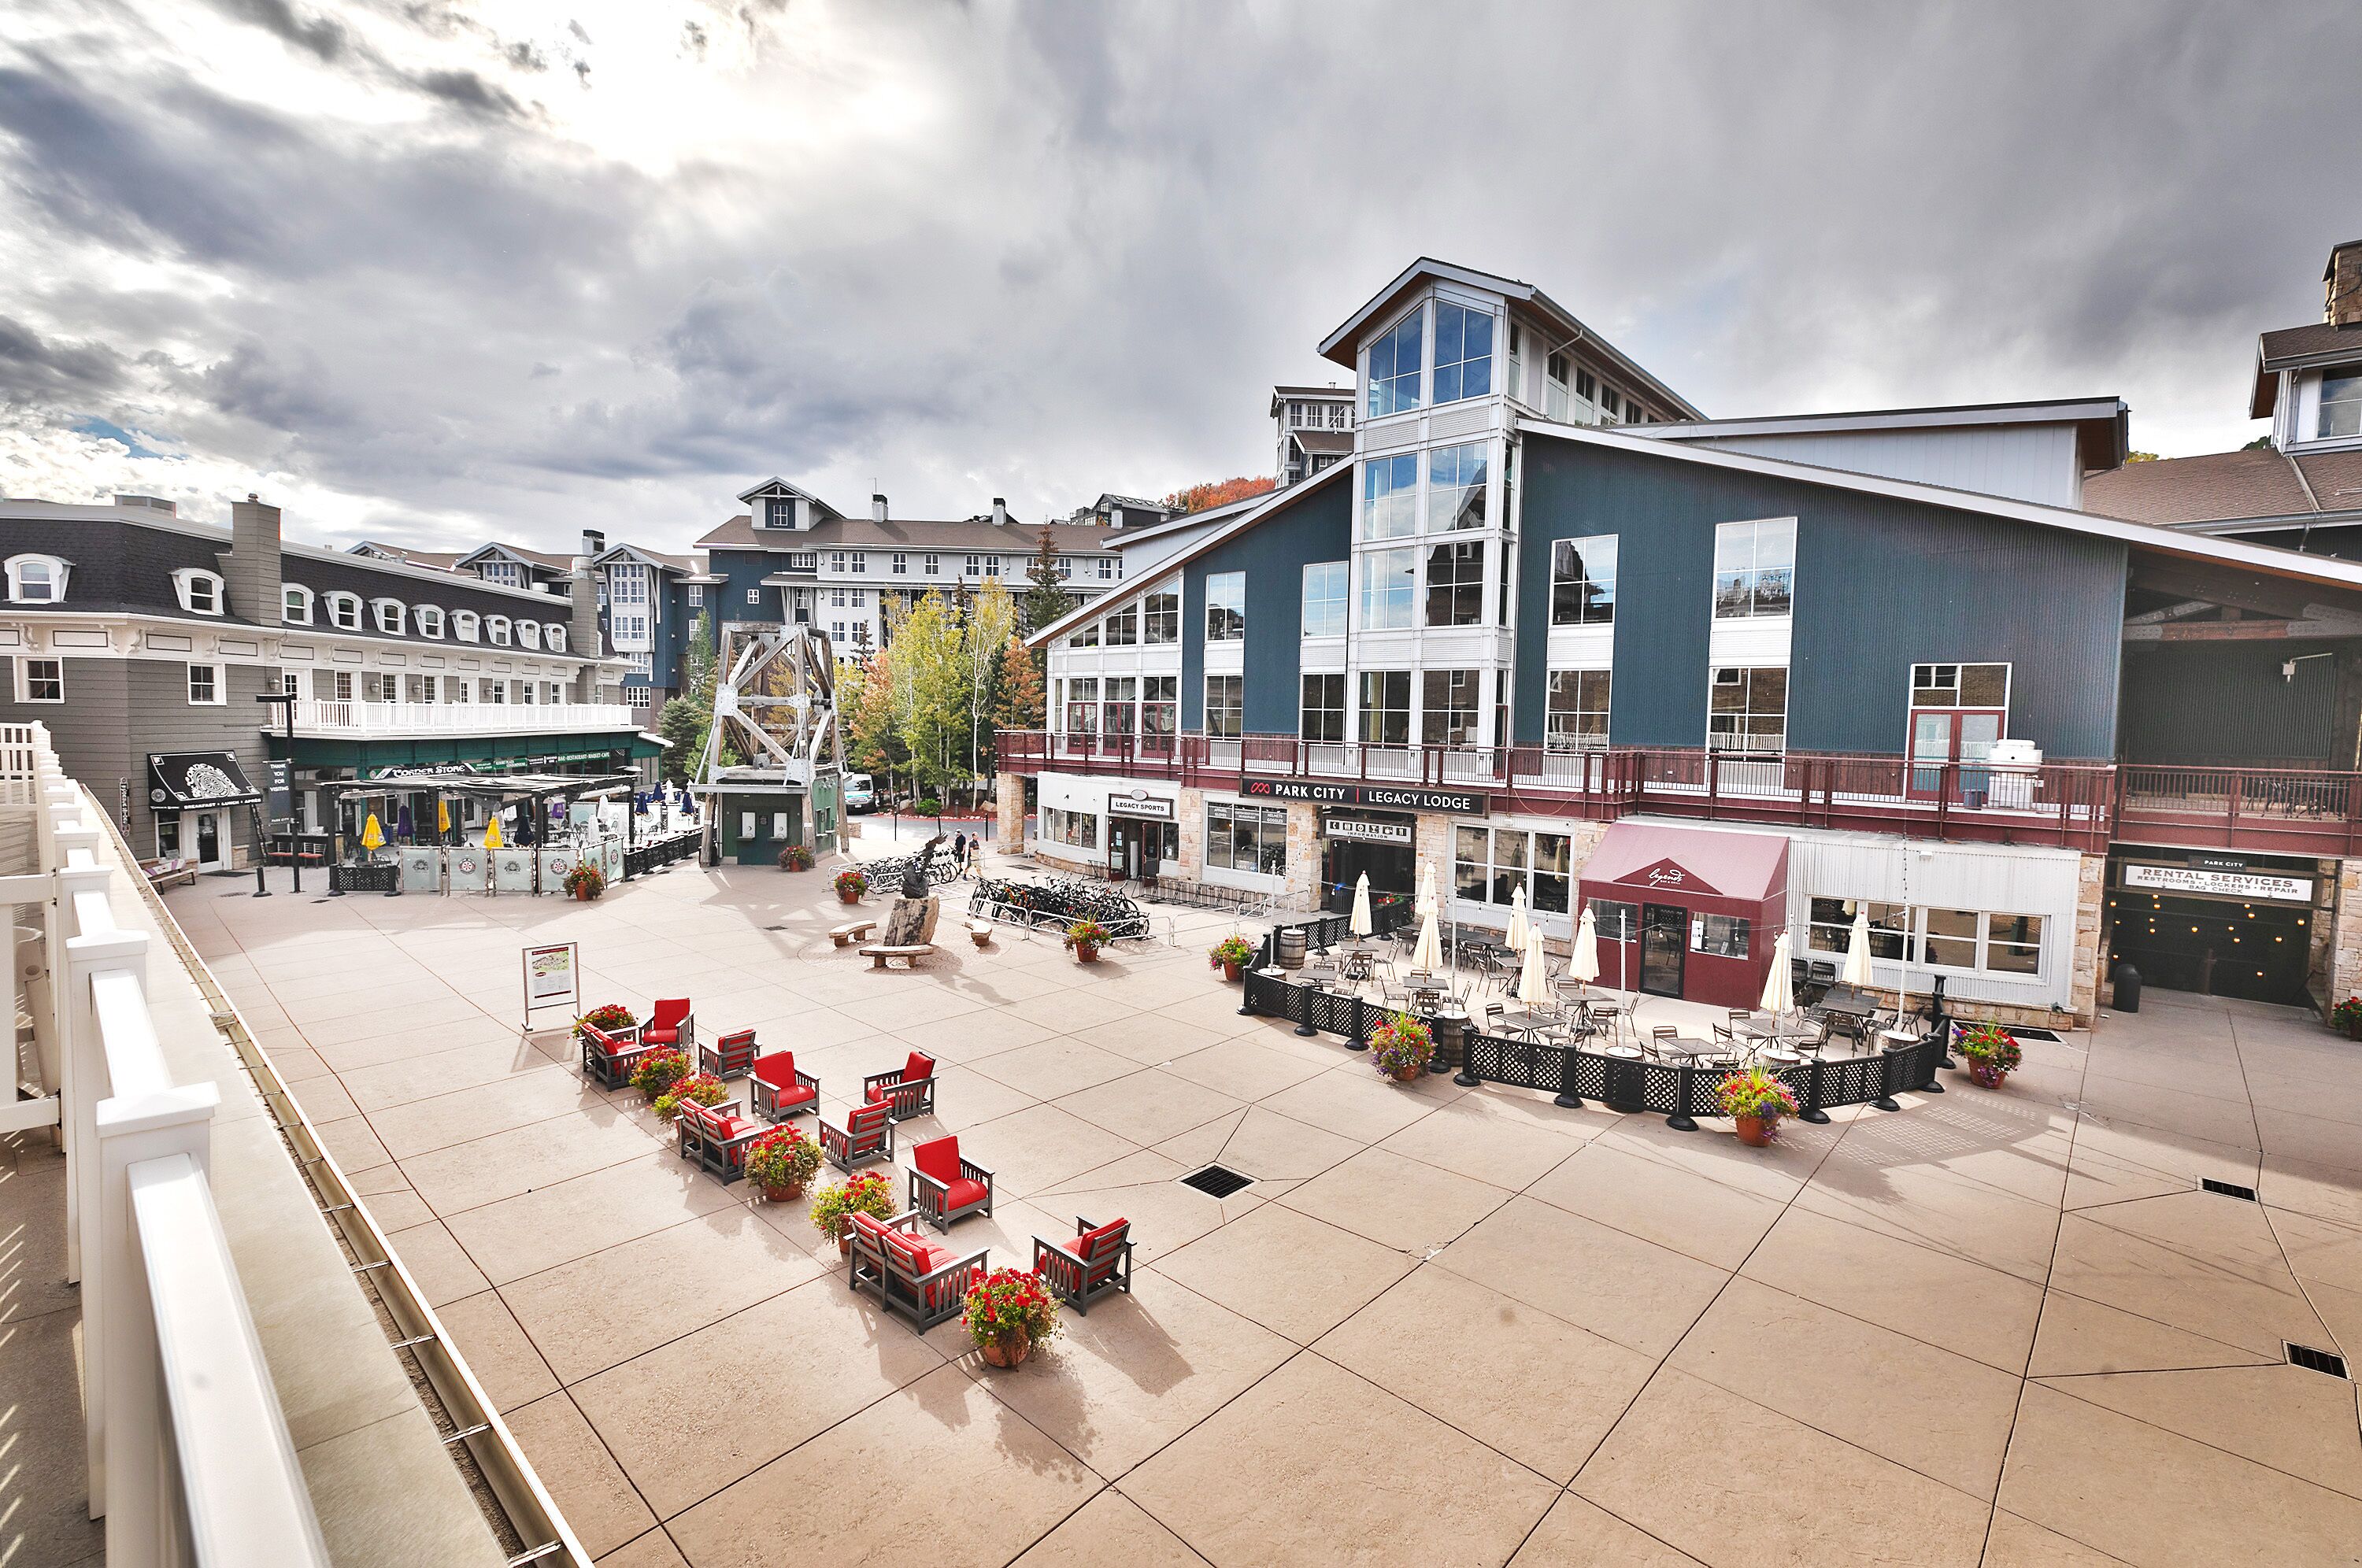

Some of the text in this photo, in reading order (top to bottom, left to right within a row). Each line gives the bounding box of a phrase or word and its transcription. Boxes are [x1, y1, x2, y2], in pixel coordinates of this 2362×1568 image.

[435, 764, 465, 775] STORE
[1275, 783, 1471, 810] PARK CITY LEGACY LODGE
[2137, 875, 2196, 885] RESTROOMS
[2205, 881, 2251, 889] LOCKERS
[2143, 868, 2294, 887] RENTAL SERVICES
